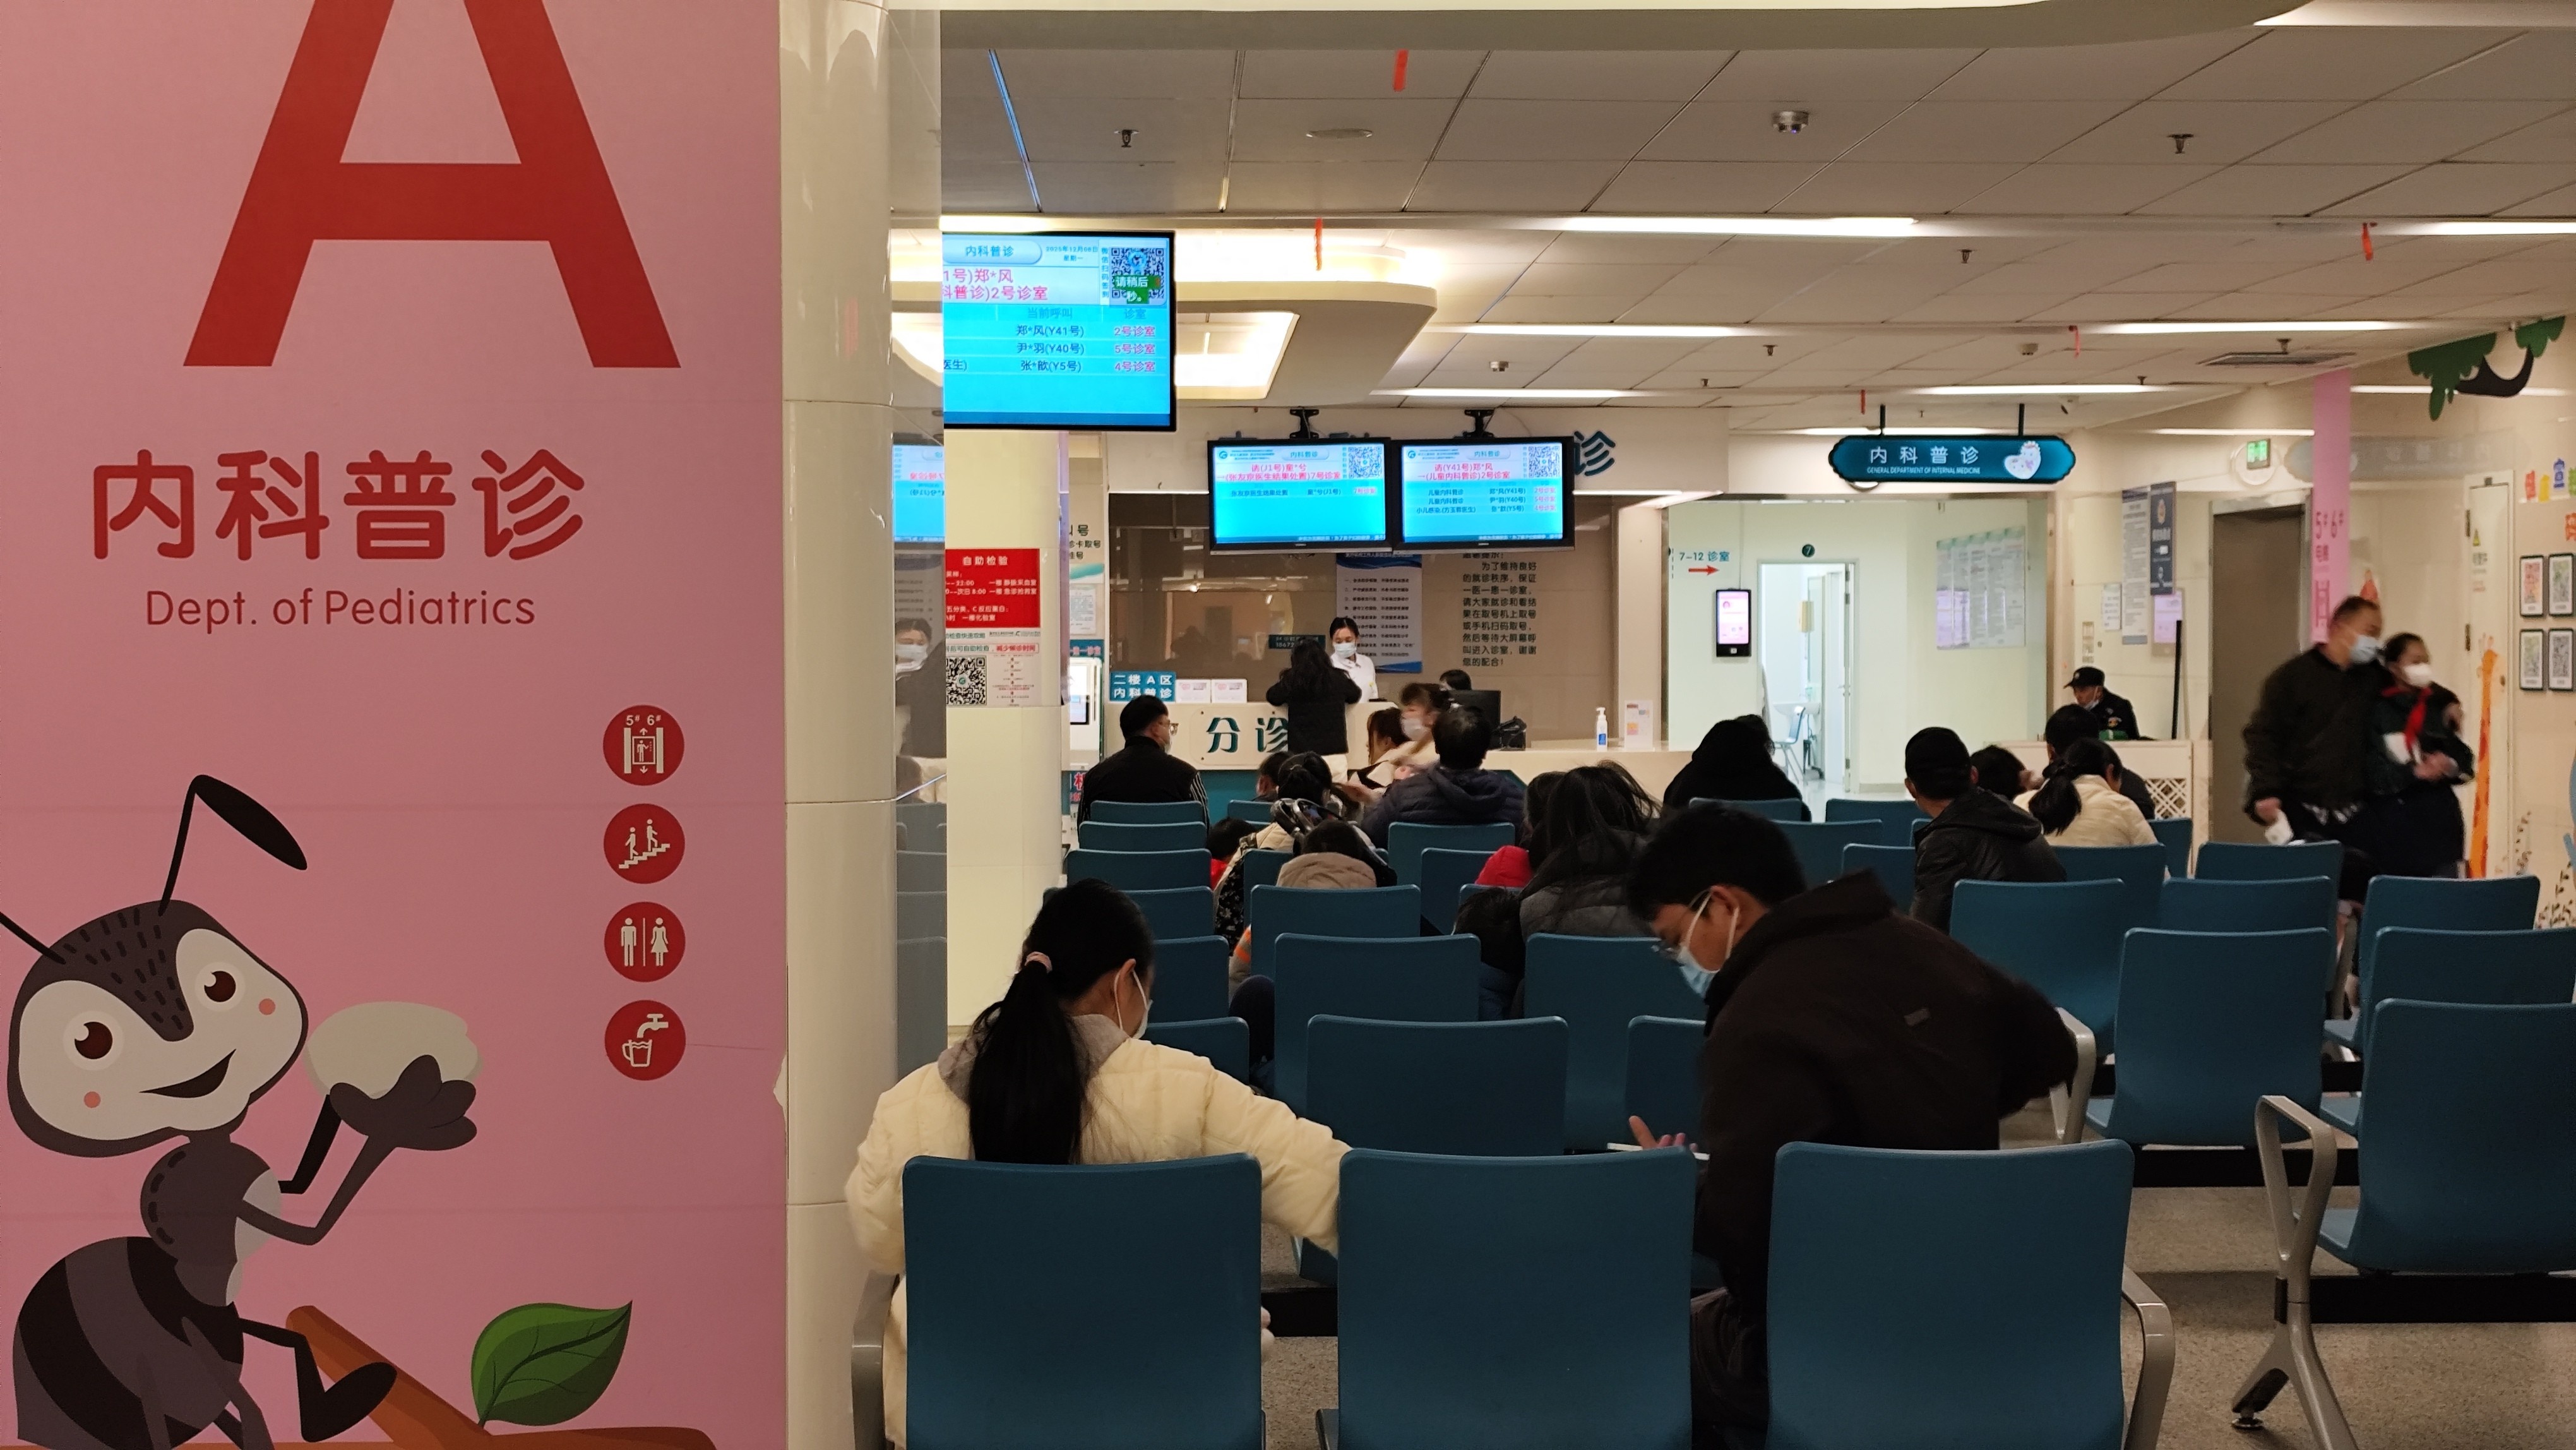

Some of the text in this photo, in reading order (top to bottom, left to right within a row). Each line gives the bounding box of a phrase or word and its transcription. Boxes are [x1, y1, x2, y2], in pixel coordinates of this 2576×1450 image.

[183, 0, 681, 368] A
[965, 245, 1014, 257] 内科普诊
[1027, 307, 1147, 320] 当前呼叫 诊室
[1114, 325, 1155, 338] 2号诊室
[1114, 343, 1155, 355] 5号诊室
[1114, 361, 1155, 373] 4号诊室
[1869, 445, 1979, 465] 内科普诊
[93, 448, 585, 561] 内科普诊
[963, 555, 1008, 566] 自助检验
[1679, 551, 1730, 562] 7-12 诊室
[146, 587, 536, 635] Dept. of Pediatrics
[1114, 674, 1172, 686] 二楼A区
[1114, 687, 1172, 699] 内科普诊
